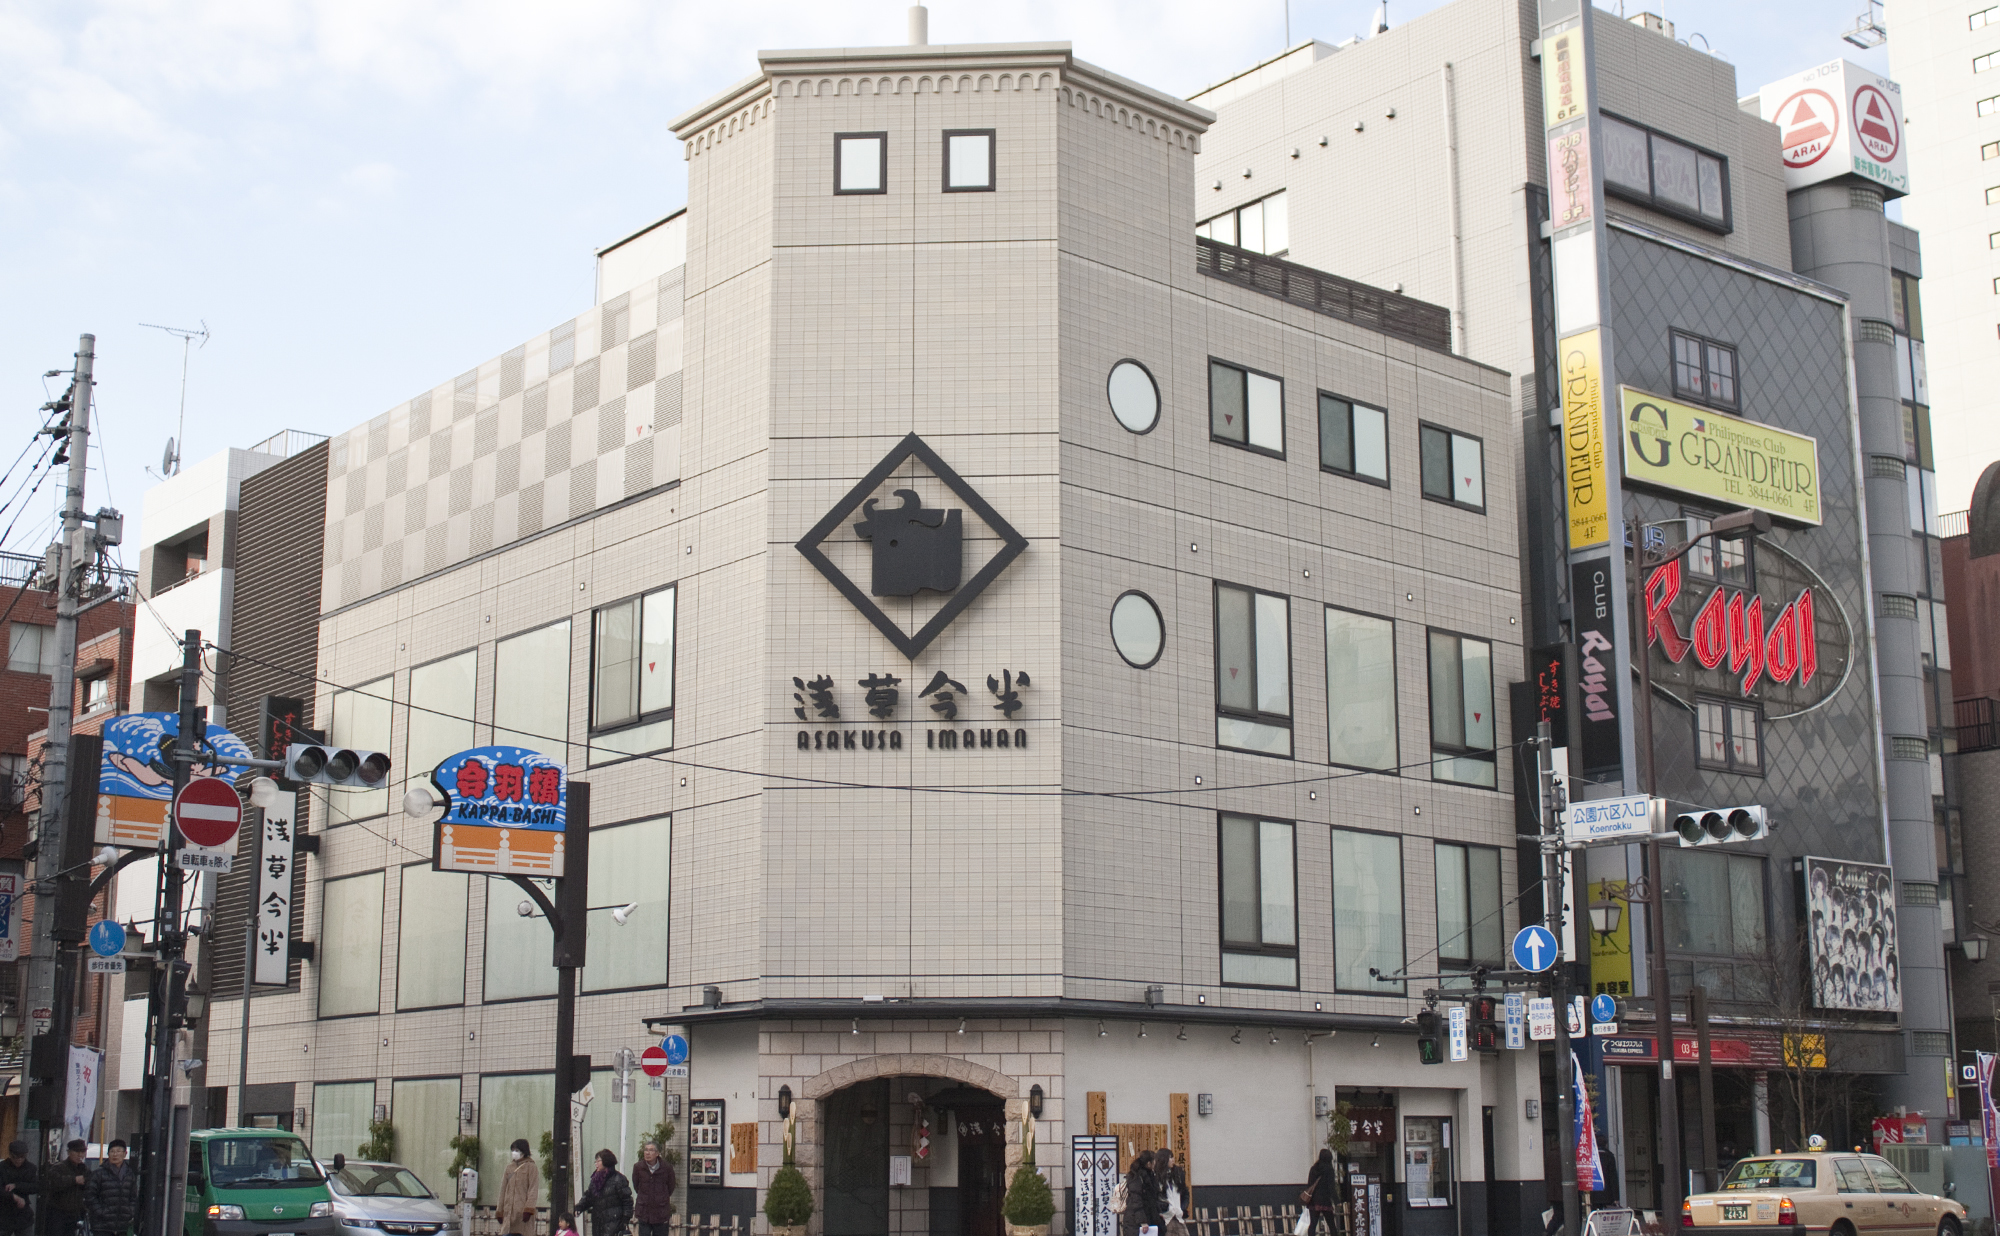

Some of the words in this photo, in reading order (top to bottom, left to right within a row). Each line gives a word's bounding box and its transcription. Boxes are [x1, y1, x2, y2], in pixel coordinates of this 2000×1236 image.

[1816, 61, 1840, 77] 105
[1885, 78, 1901, 95] 105
[1556, 132, 1581, 151] PUB
[1792, 142, 1821, 160] ARAI
[1868, 138, 1889, 154] ARAI
[1565, 349, 1594, 507] GRANDEUR
[1708, 421, 1762, 449] Philippines
[1763, 436, 1786, 455] Club
[1593, 441, 1603, 469] Club
[1679, 431, 1813, 497] GRANDEUR
[1723, 477, 1743, 496] TEL
[1748, 483, 1794, 509] 3844-0661
[1803, 499, 1815, 513] 4F
[1571, 510, 1608, 529] 3844-0661
[1582, 525, 1597, 540] 4F
[1593, 570, 1607, 620] CLUB
[1645, 555, 1818, 698] Royal
[1578, 629, 1616, 722] Royal
[792, 668, 1031, 721] 浅草今半
[797, 729, 903, 750] ASAKUSA
[927, 728, 1028, 749] IMAHAN
[456, 758, 562, 806] 合羽橋
[1573, 801, 1647, 826] 公園六区入口
[1589, 820, 1632, 835] Koenrokku
[181, 853, 229, 869] 自転車を除く
[261, 818, 291, 956] 浅草今半
[1596, 981, 1629, 995] 美容室
[1681, 1043, 1690, 1054] 03
[1080, 1178, 1090, 1236] 浅草今半
[1100, 1178, 1111, 1236] 浅草今半
